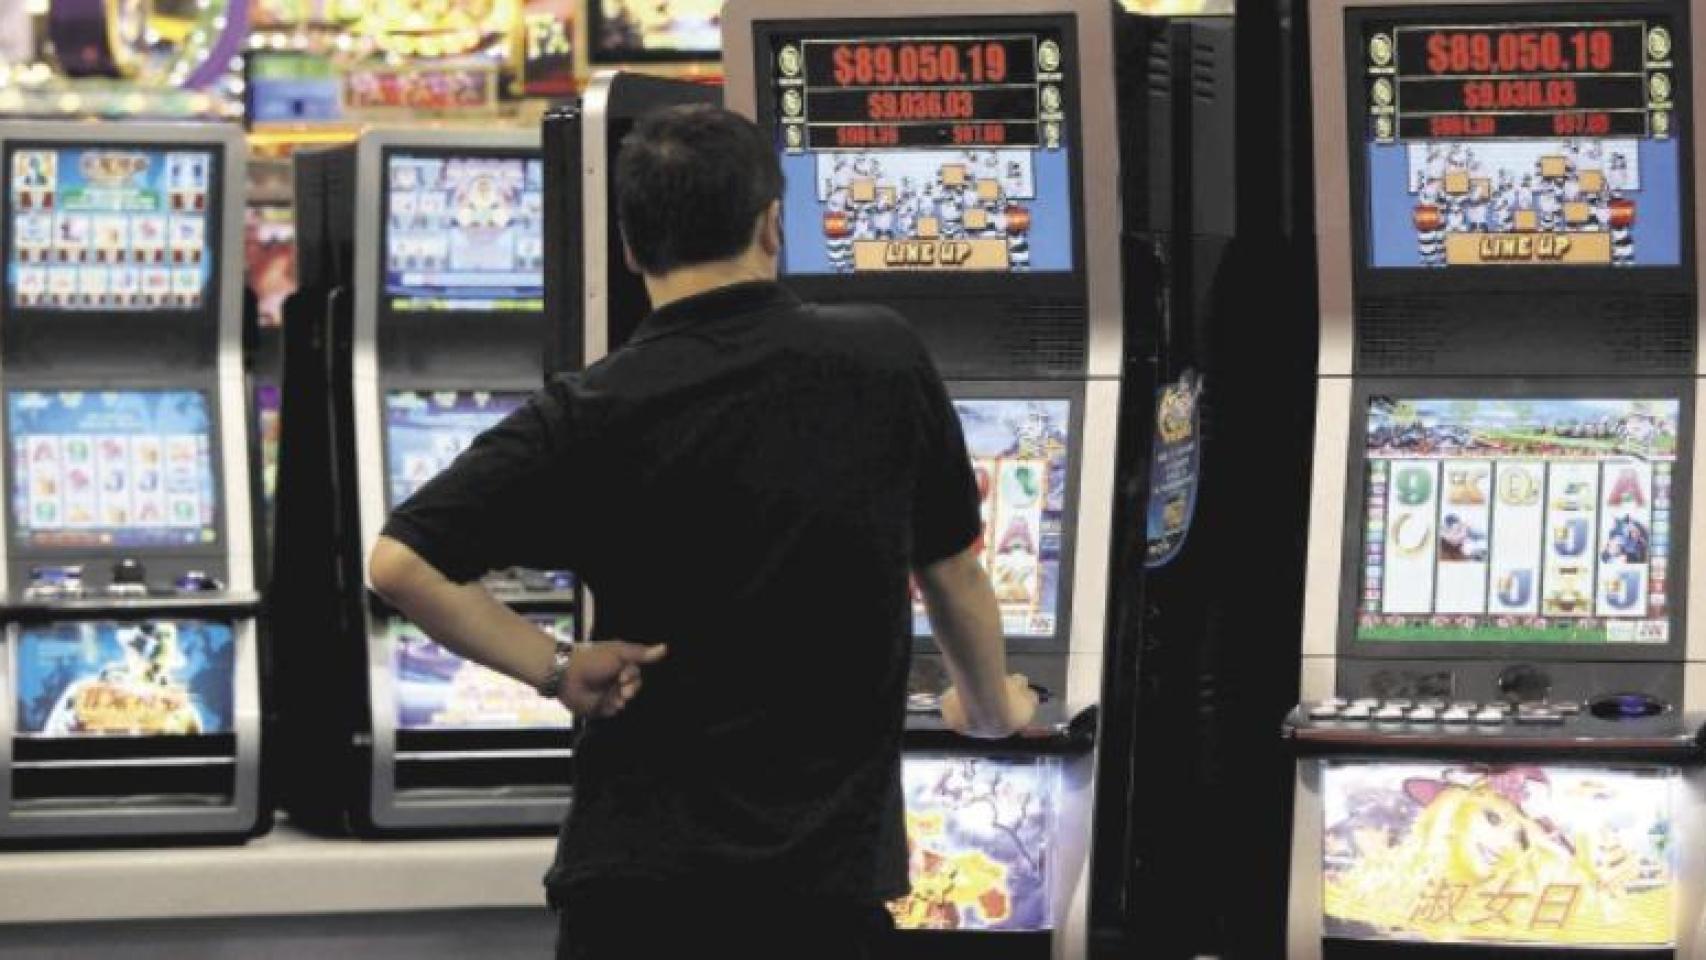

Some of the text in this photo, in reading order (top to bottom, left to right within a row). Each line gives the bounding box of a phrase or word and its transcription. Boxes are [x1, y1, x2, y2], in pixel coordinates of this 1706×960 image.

[834, 43, 1006, 86] $89,050.19
[1427, 31, 1612, 74] $89,050.19
[886, 242, 972, 265] LINE UP
[1479, 236, 1571, 262] LINE UP
[1397, 467, 1432, 506] 9
[1608, 468, 1646, 506] A
[999, 518, 1035, 555] A
[1554, 517, 1589, 556] J
[1499, 569, 1533, 607] J
[1606, 571, 1641, 609] J
